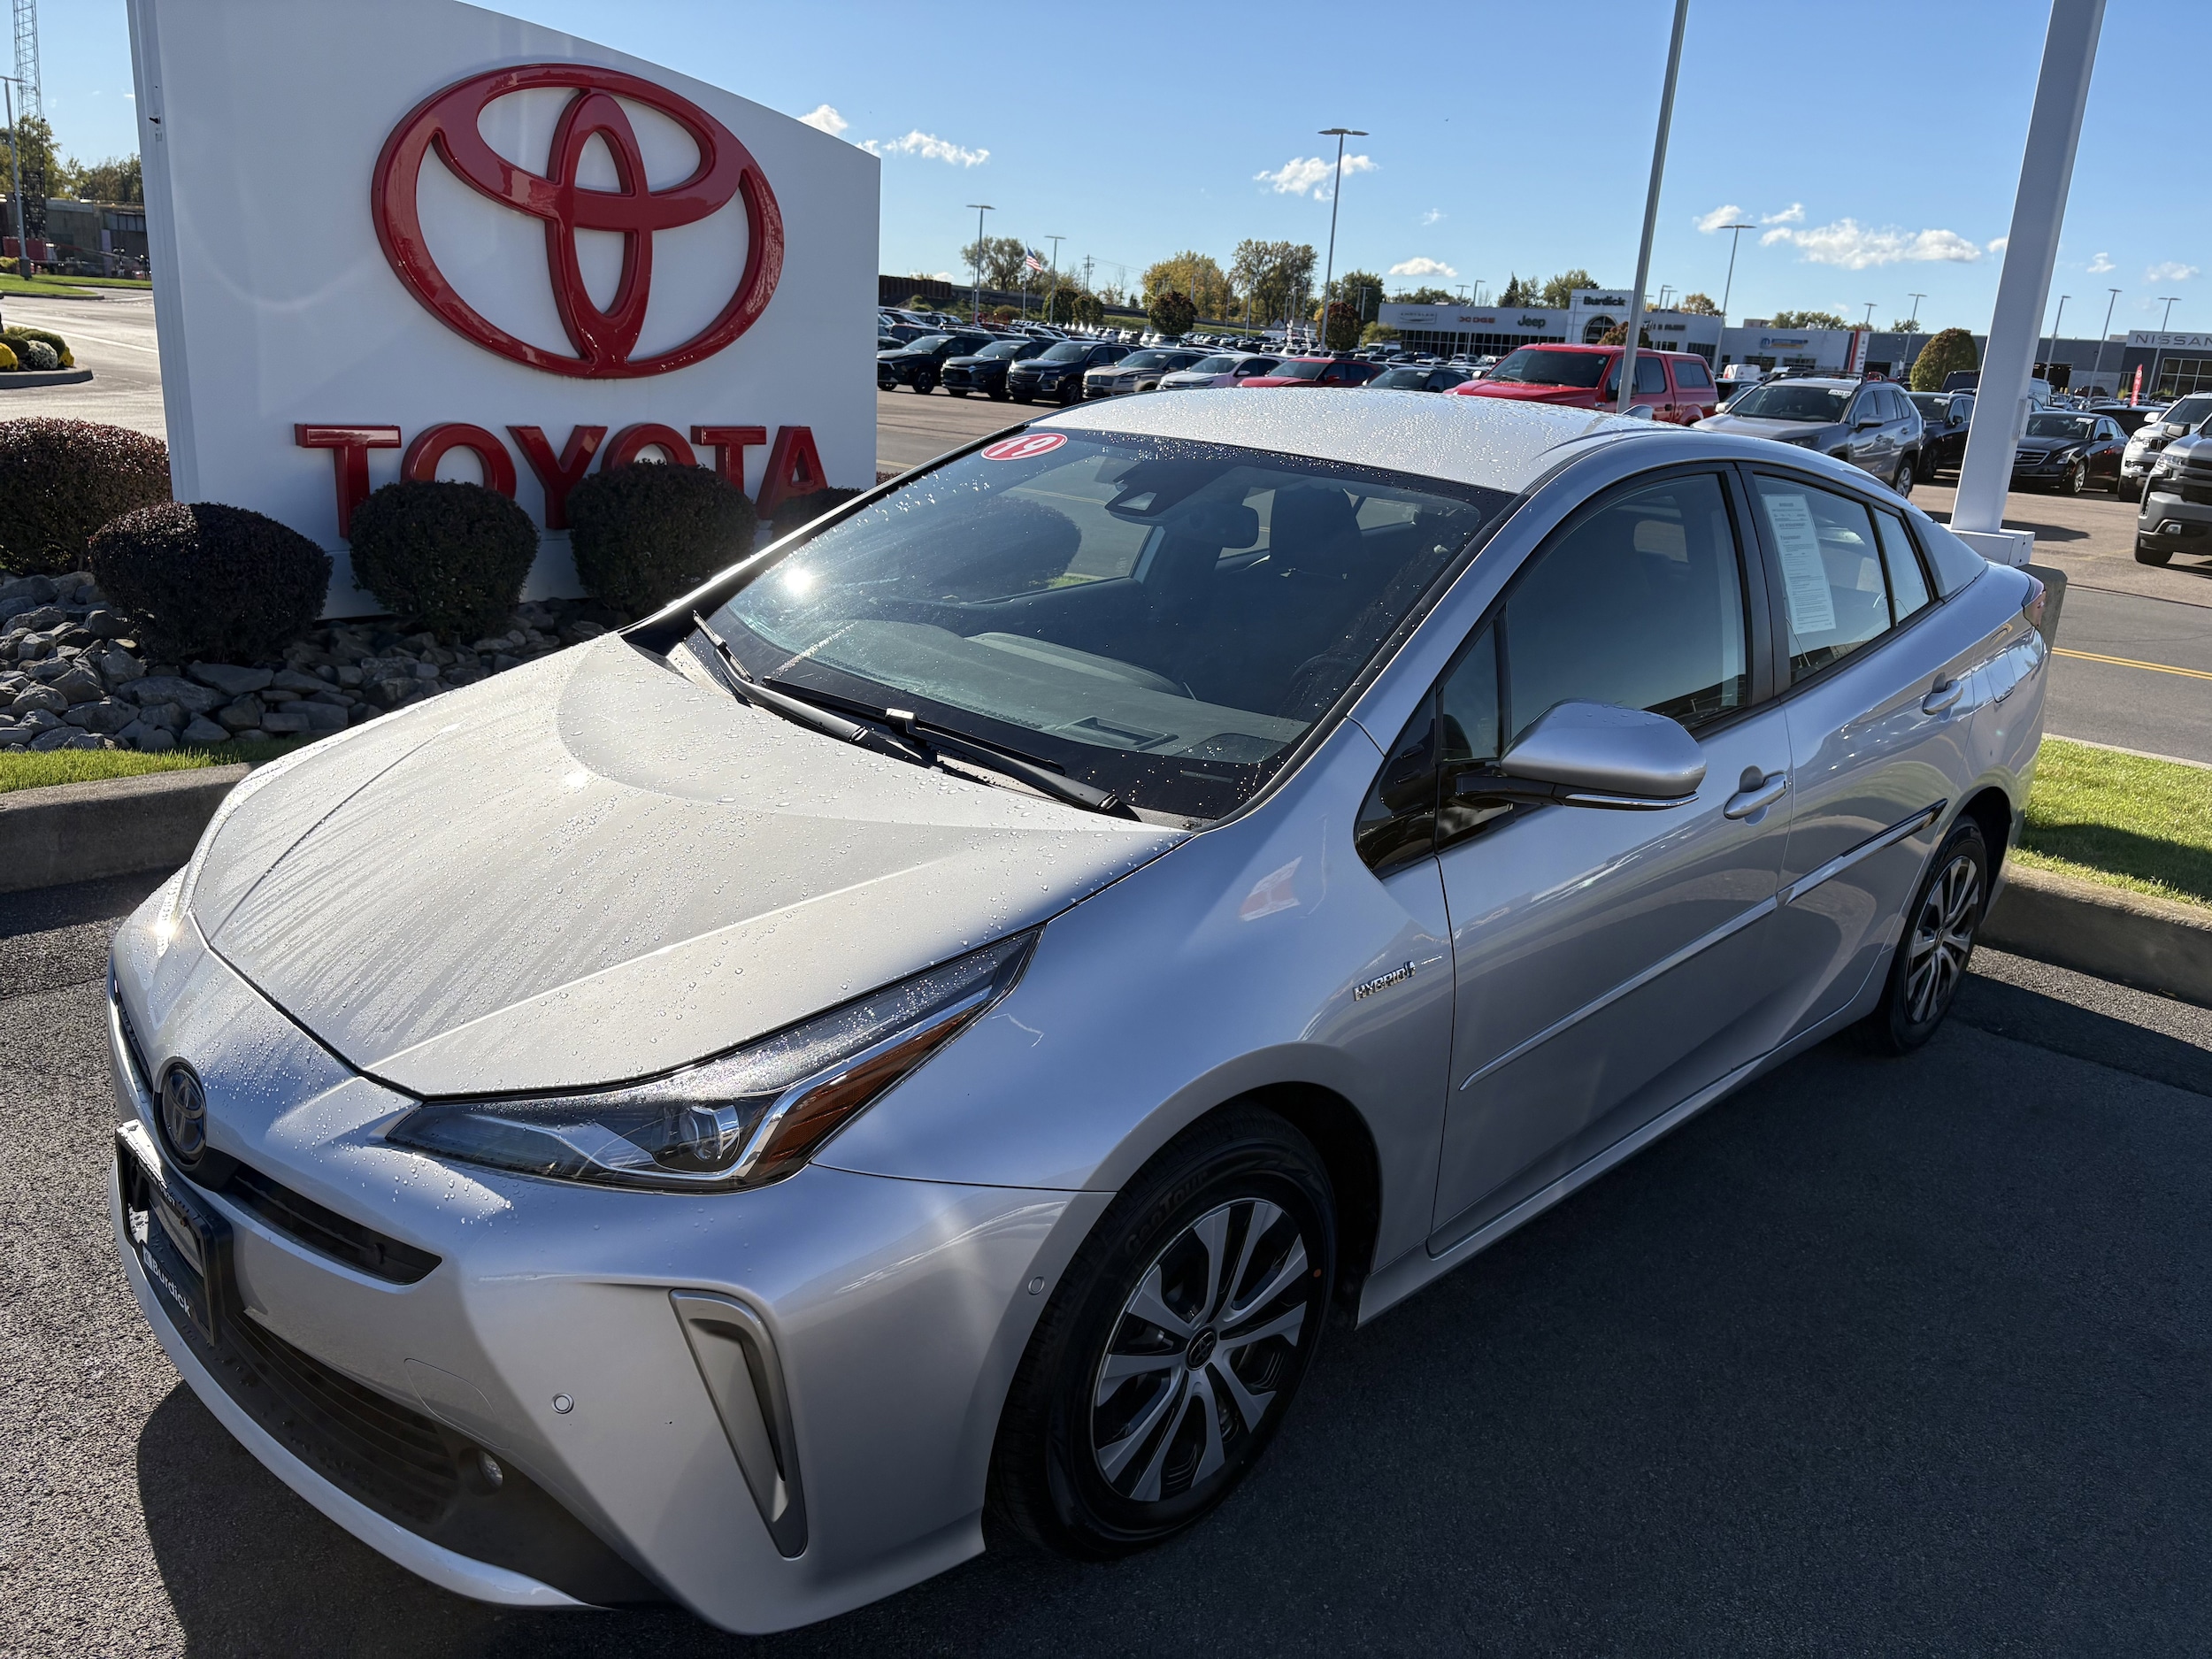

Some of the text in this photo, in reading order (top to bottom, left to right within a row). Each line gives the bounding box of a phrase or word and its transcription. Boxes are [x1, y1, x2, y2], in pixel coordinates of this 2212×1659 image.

[1458, 316, 1496, 325] DODGE
[1517, 314, 1547, 330] Jeep
[1352, 967, 1408, 1002] HYBRID
[151, 1257, 191, 1319] Burdick
